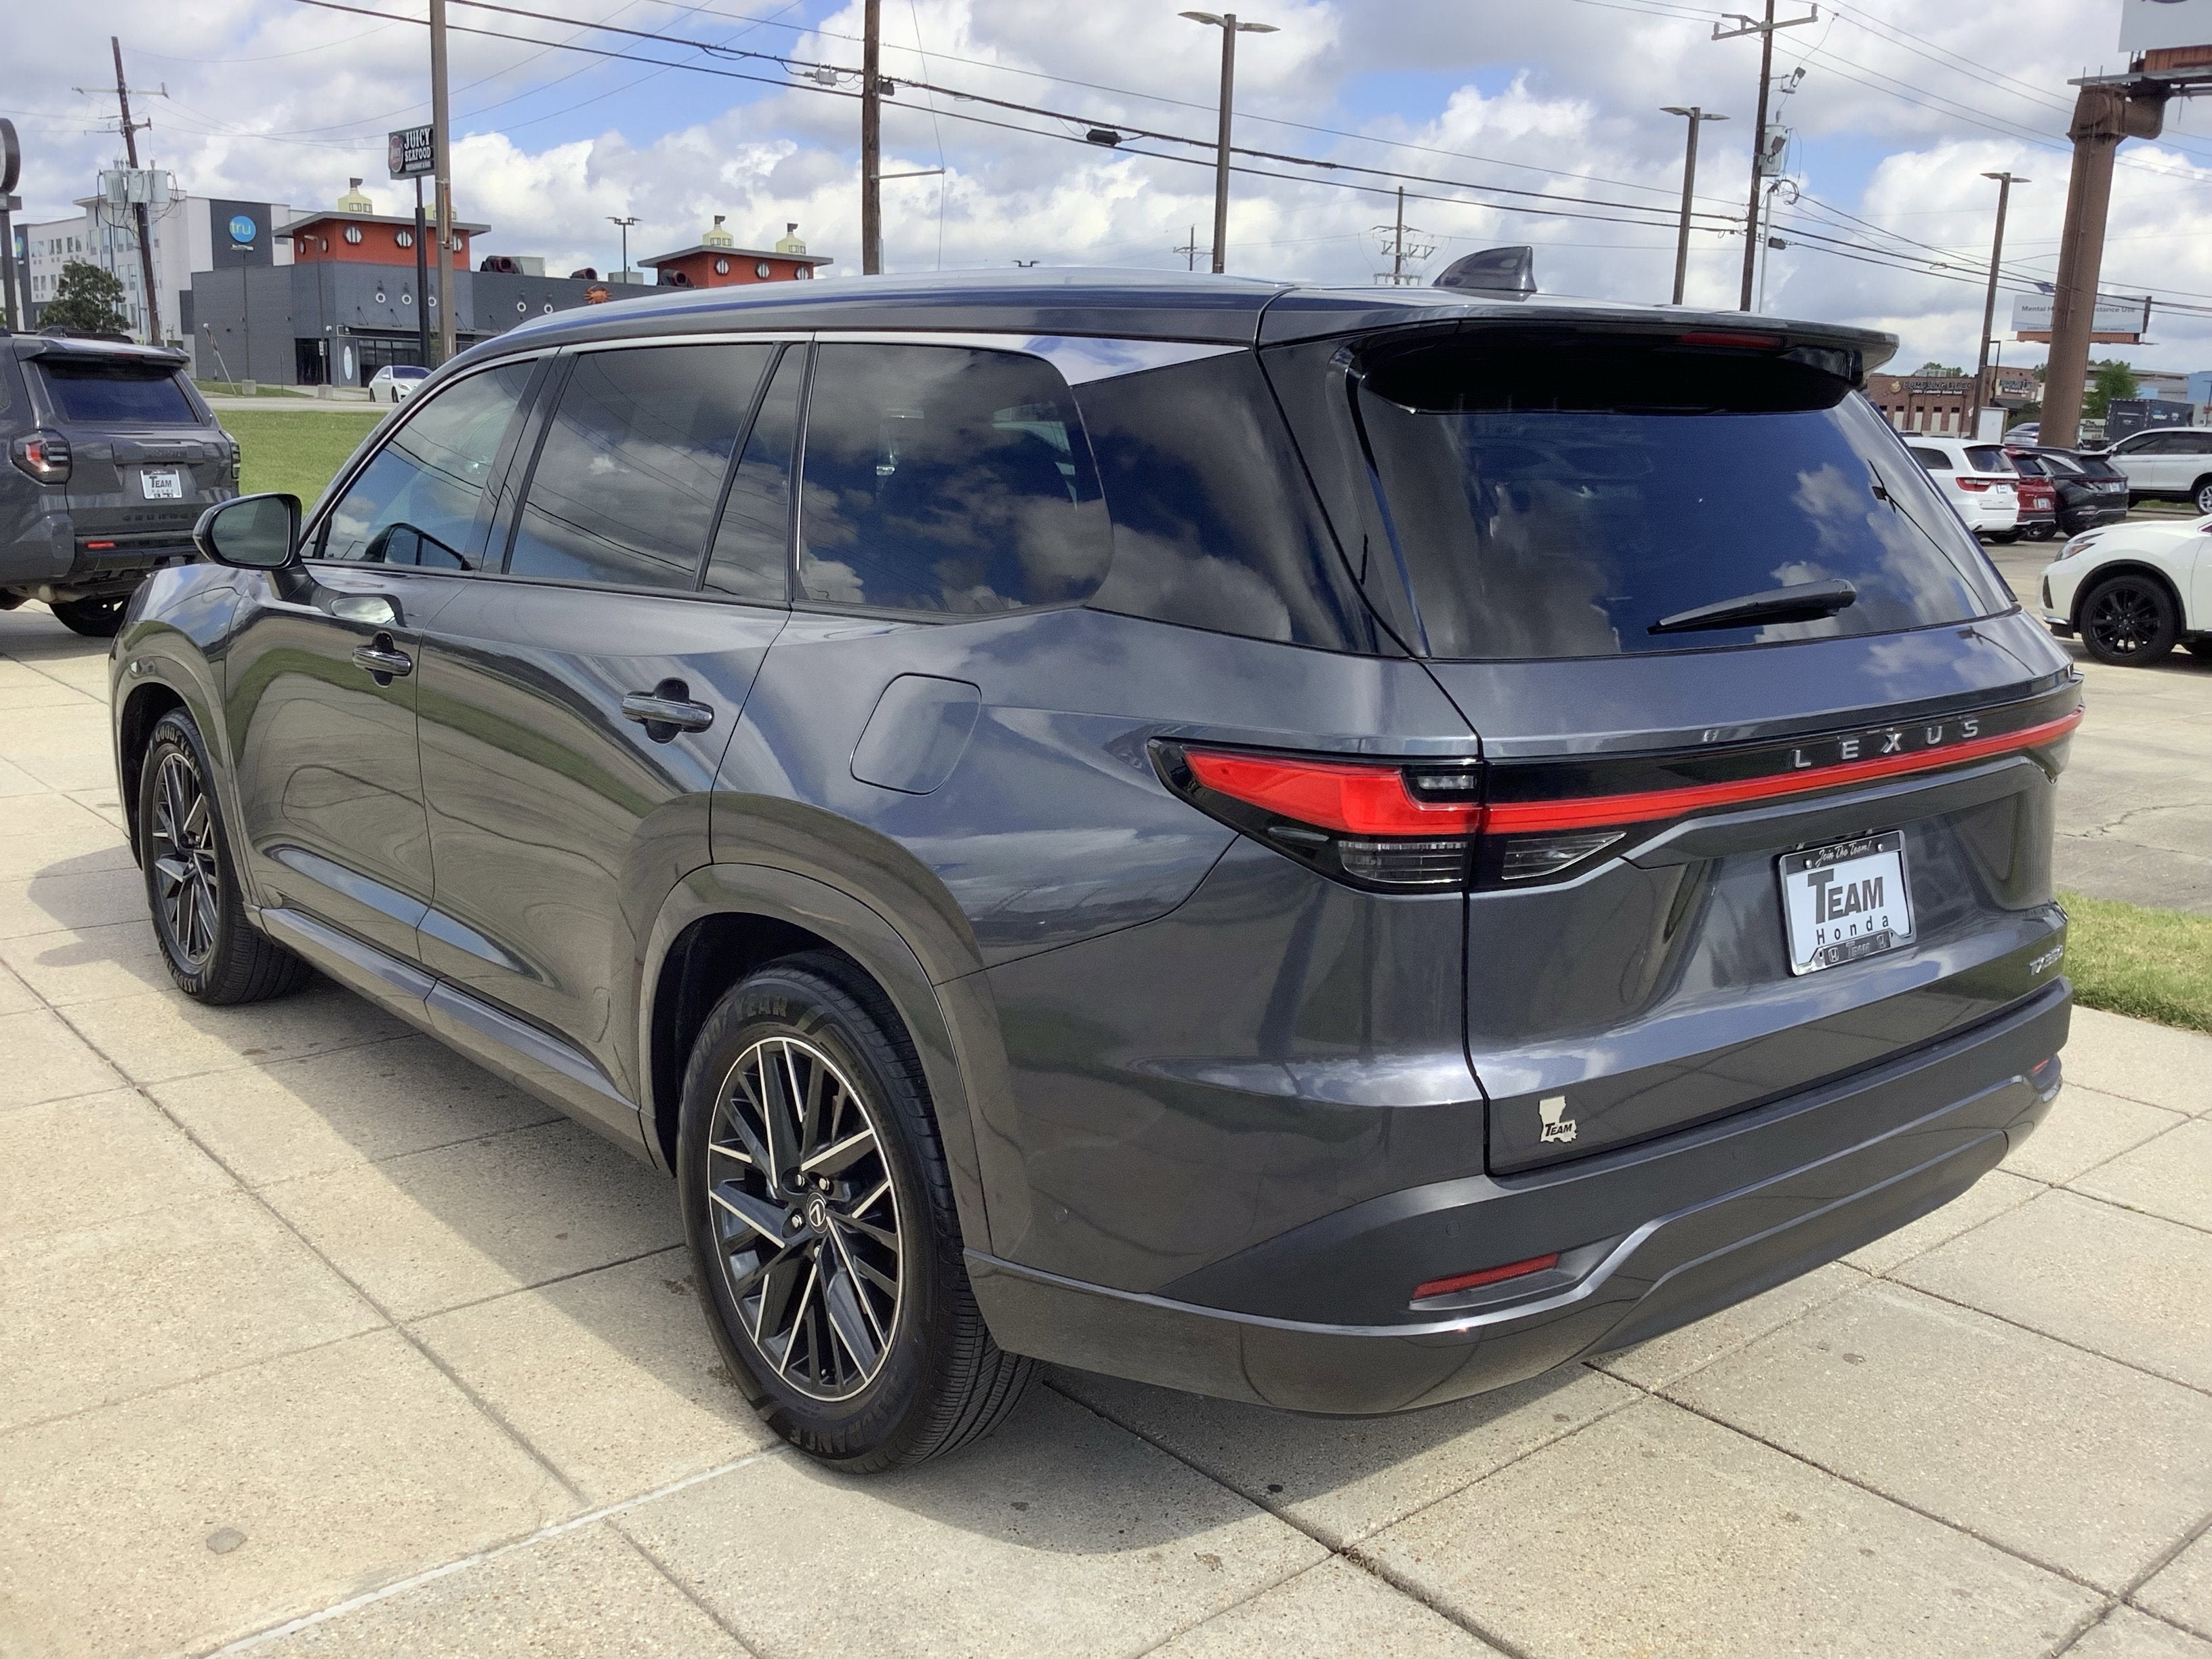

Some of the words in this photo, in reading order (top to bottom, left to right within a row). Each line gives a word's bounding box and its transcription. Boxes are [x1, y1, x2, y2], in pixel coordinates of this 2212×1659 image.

[404, 128, 430, 149] JUICY
[405, 146, 431, 162] SEAFOOD
[230, 221, 251, 235] tru
[149, 476, 172, 488] TEAM
[1795, 719, 1979, 768] LEXUS
[1815, 848, 1835, 867] Join
[1835, 844, 1849, 859] The
[1849, 840, 1872, 856] Team!
[1807, 867, 1884, 924] TEAM
[1816, 915, 1889, 945] Honda
[1545, 1122, 1572, 1136] TEAM
